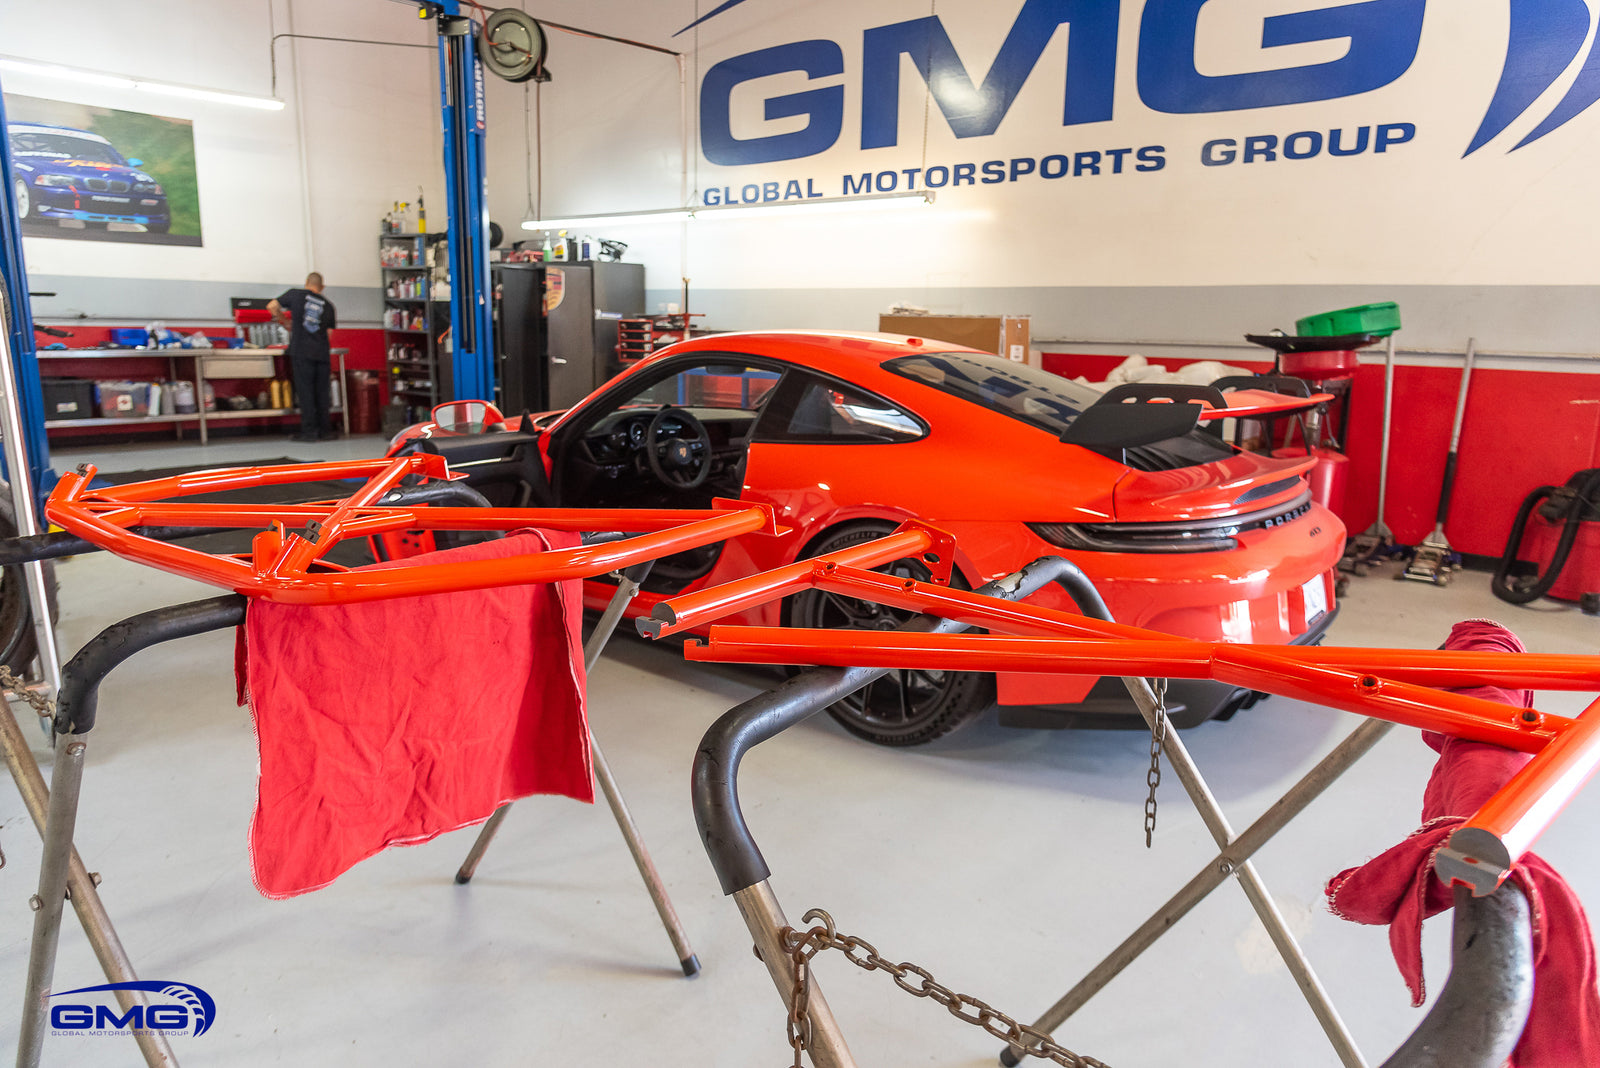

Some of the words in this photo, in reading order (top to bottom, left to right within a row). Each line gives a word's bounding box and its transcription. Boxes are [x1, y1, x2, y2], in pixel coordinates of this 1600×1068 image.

[474, 59, 484, 121] ROTARY
[700, 0, 1427, 167] GMG
[703, 178, 823, 206] GLOBAL
[843, 145, 1166, 195] MOTORSPORTS
[1200, 122, 1417, 167] GROUP
[1264, 503, 1311, 529] PORSCH
